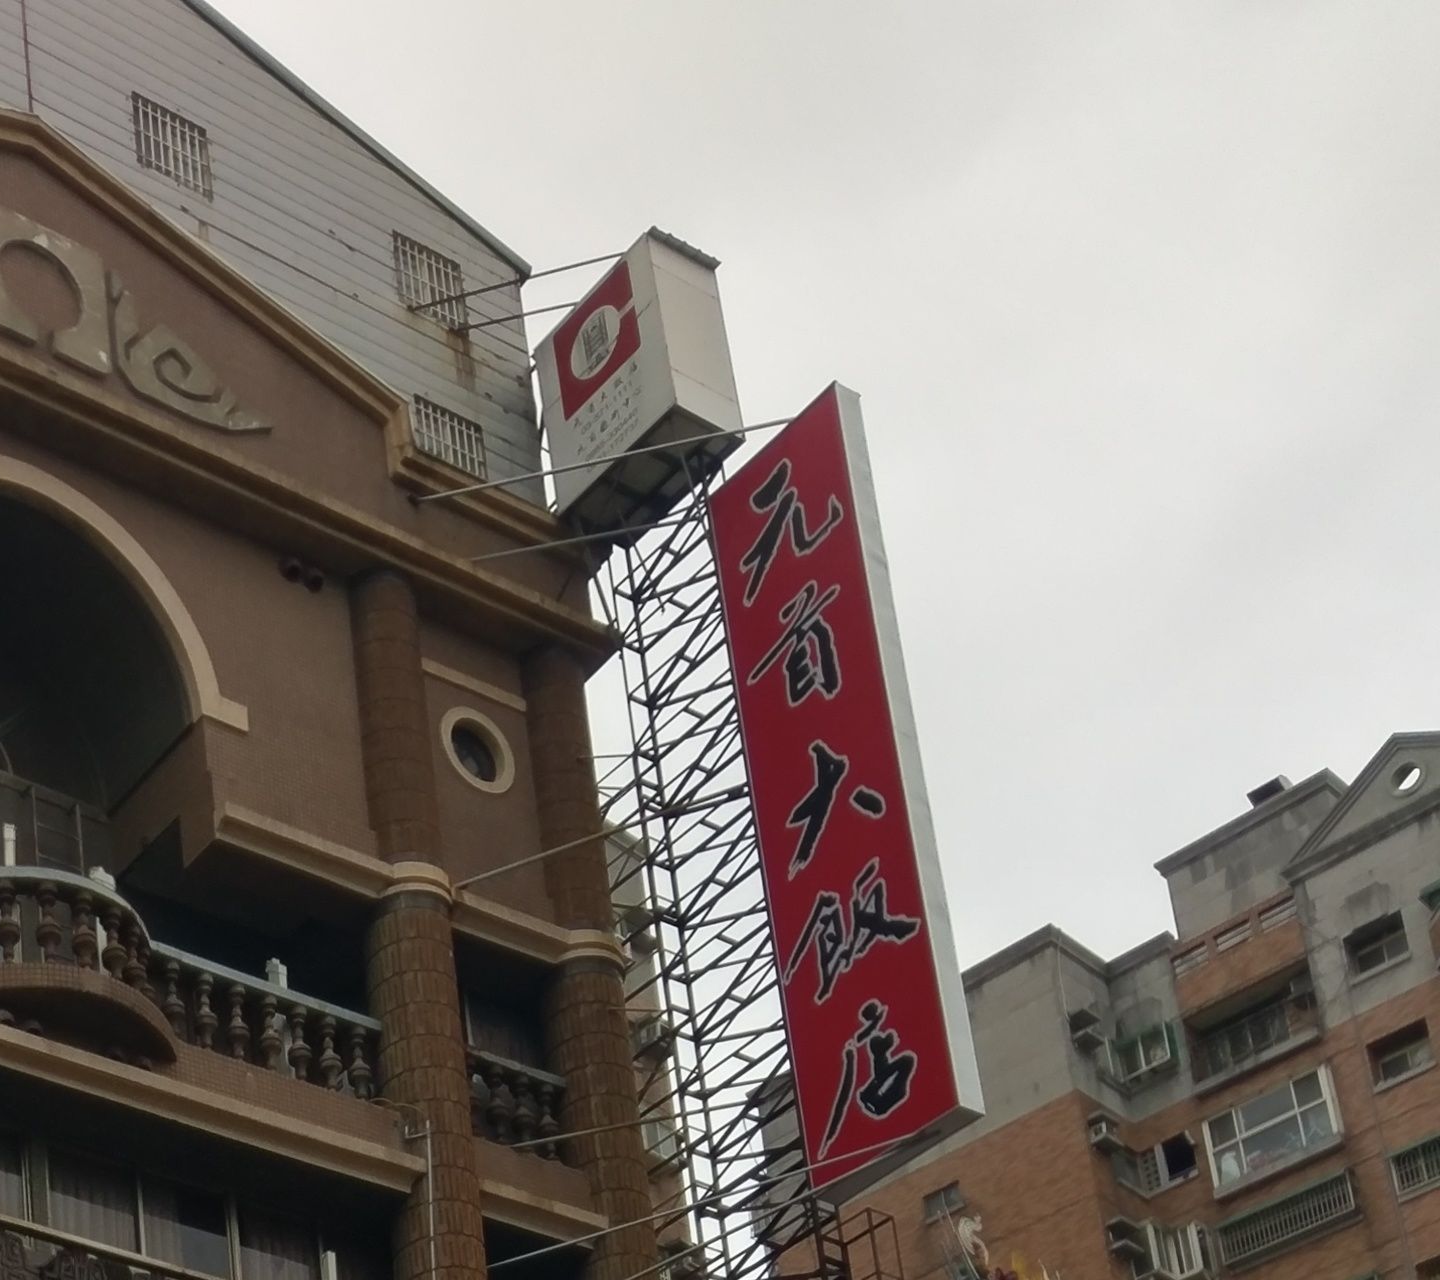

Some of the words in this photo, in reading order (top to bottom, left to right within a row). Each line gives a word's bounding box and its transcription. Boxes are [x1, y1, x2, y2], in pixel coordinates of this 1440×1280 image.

[739, 461, 919, 1157] 元首大飯店
